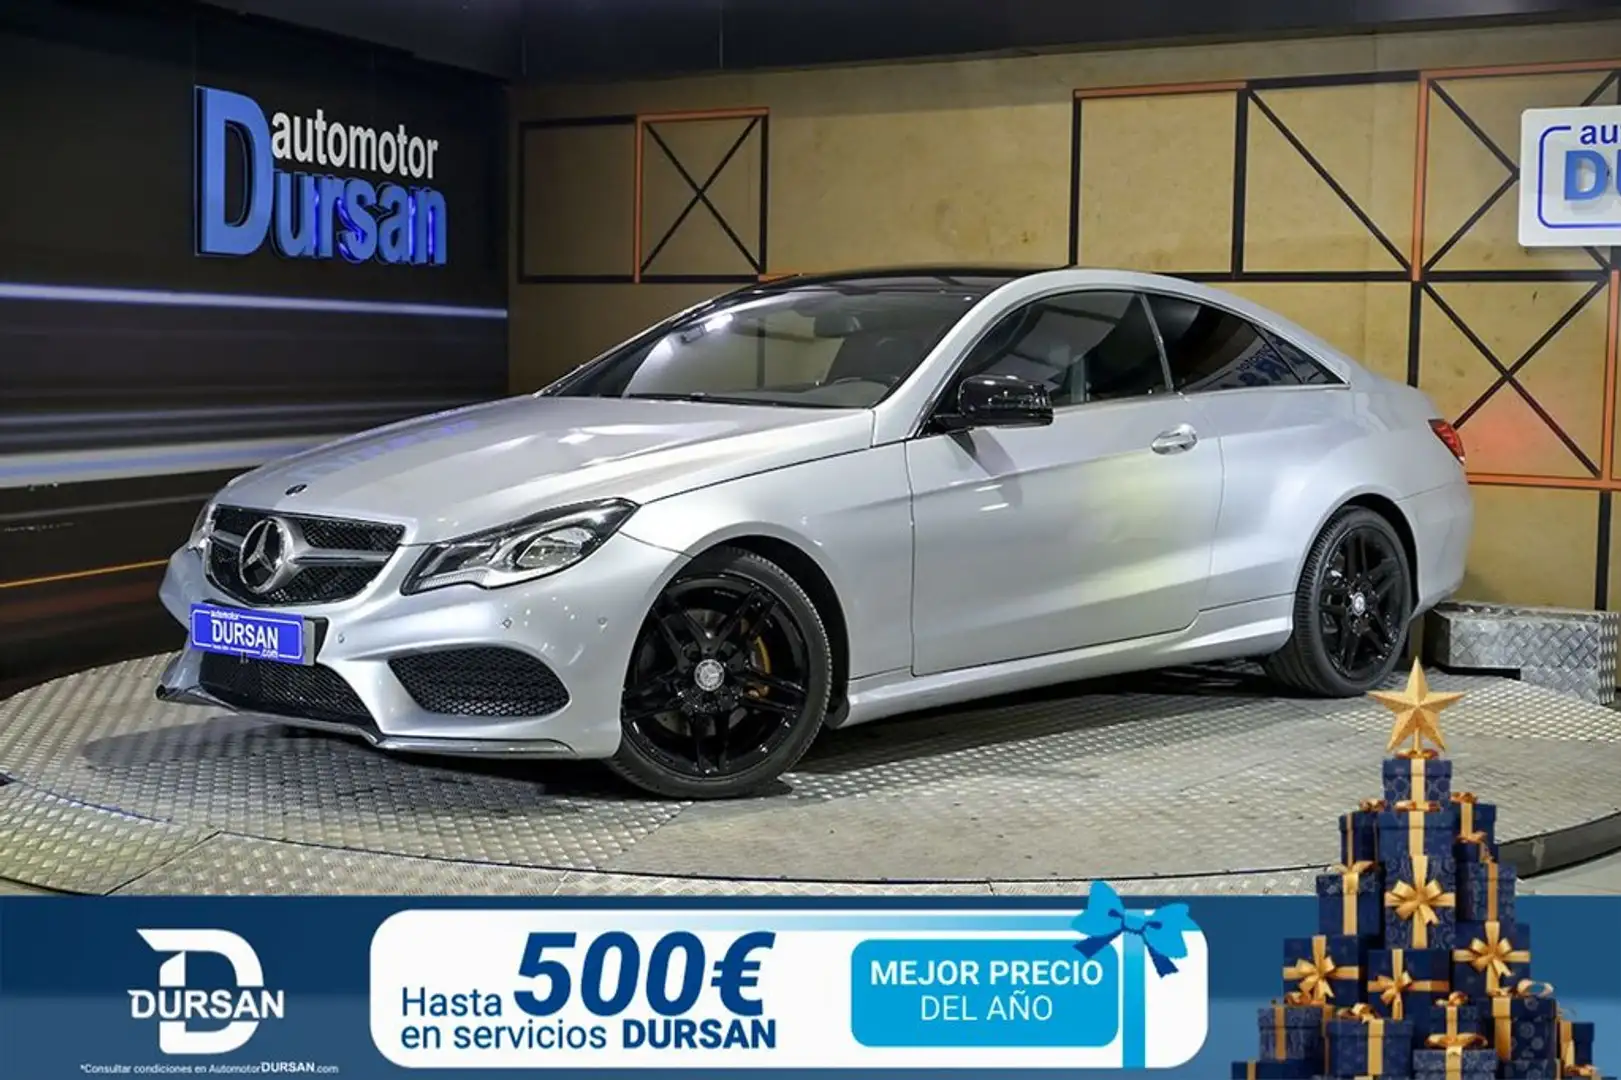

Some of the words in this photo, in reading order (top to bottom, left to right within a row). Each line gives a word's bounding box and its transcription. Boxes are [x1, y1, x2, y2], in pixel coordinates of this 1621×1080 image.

[271, 109, 438, 179] automotor
[1580, 123, 1621, 145] au
[195, 85, 448, 266] Dursan
[1564, 149, 1621, 201] D
[211, 619, 279, 651] DURSAN
